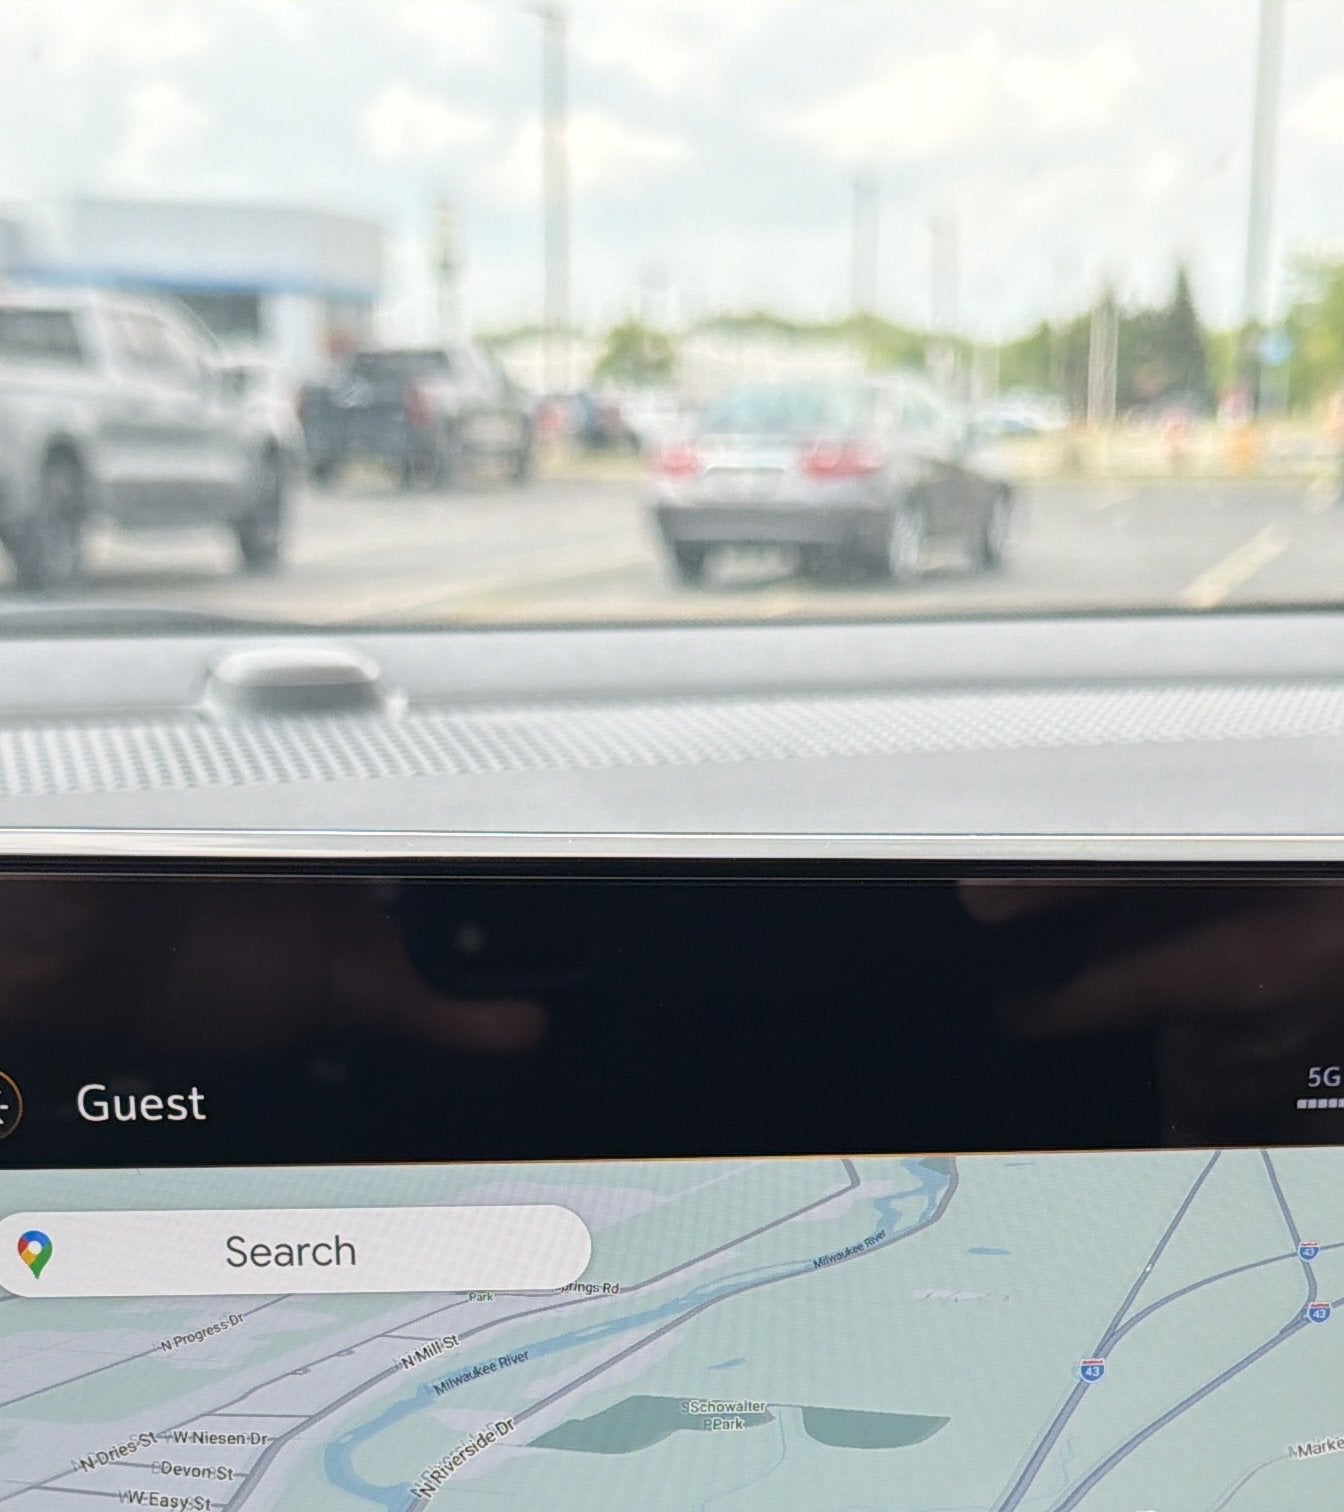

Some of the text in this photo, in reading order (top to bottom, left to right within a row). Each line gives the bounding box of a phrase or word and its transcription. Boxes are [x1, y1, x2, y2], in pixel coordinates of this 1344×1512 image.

[1308, 1066, 1342, 1088] 5G
[77, 1084, 207, 1122] Guest
[225, 1234, 357, 1268] Search
[813, 1229, 885, 1269] Milwaukee River
[469, 1292, 493, 1301] Park
[603, 1283, 619, 1294] Rd
[161, 1313, 244, 1352] N Progress Dr
[401, 1334, 460, 1369] N Mill St
[433, 1351, 529, 1396] Milwaukee River
[690, 1400, 765, 1413] Schowalter
[713, 1416, 743, 1430] Park
[79, 1430, 158, 1471] N Dries St
[174, 1431, 268, 1445] W Niesen Dr
[161, 1461, 234, 1481] Devon St
[419, 1418, 515, 1499] N Riverside Dr
[128, 1490, 211, 1511] W Easy St
